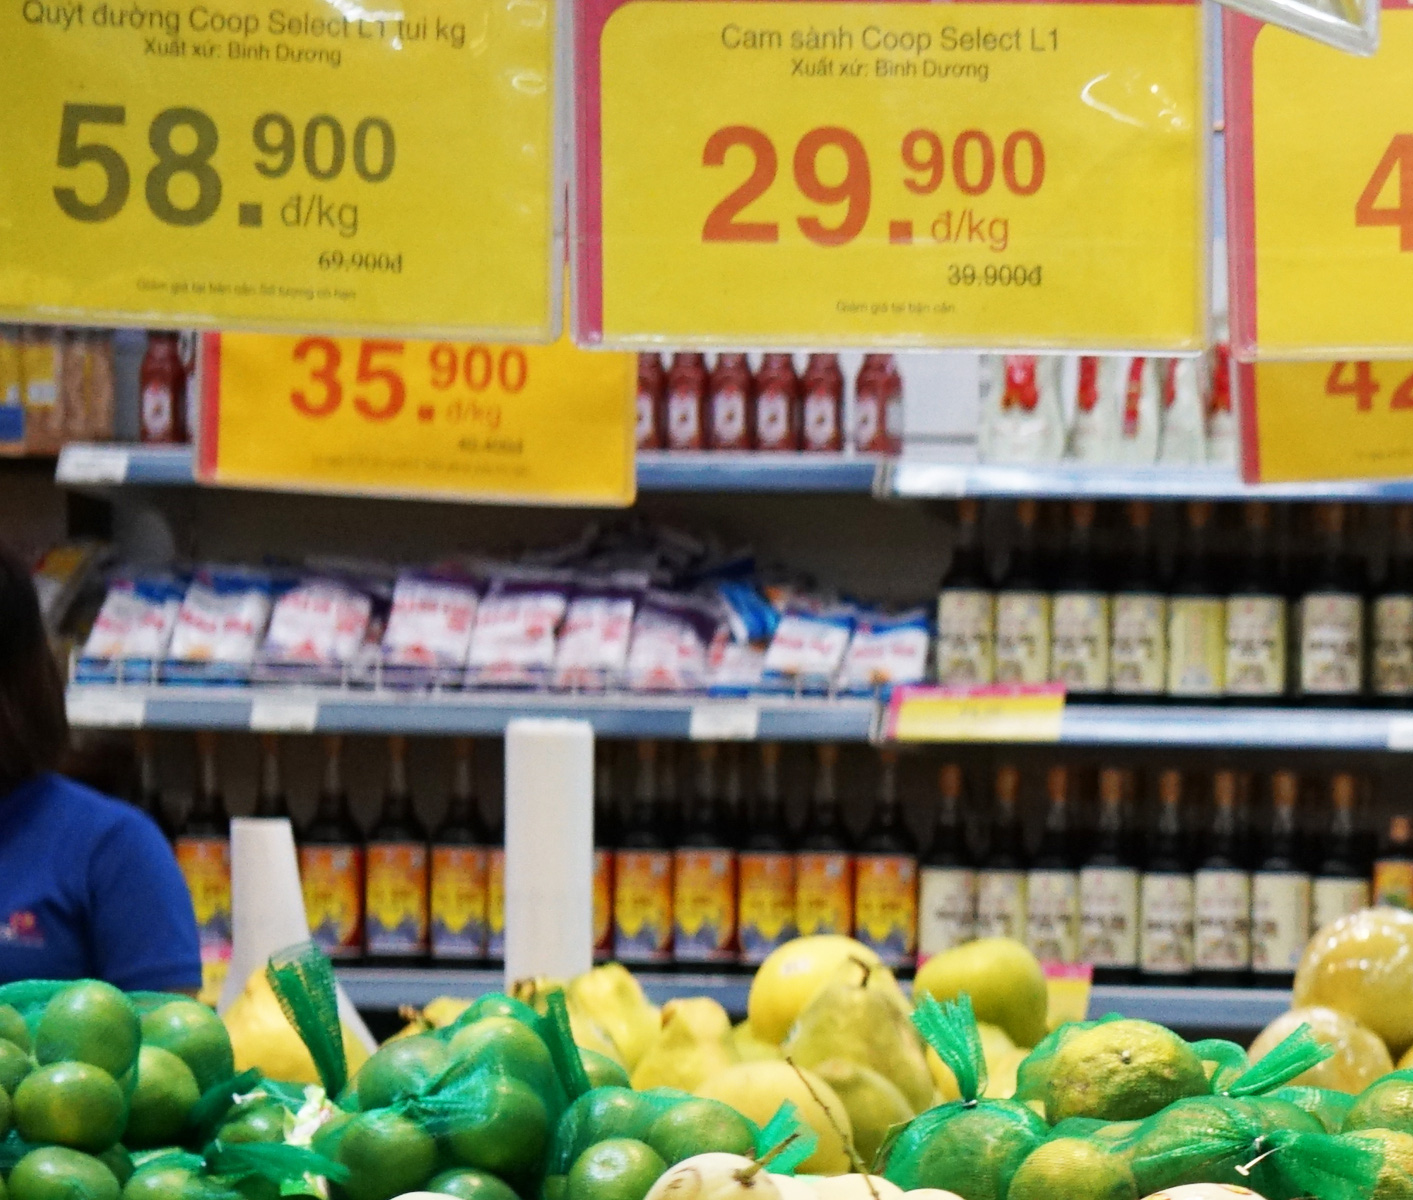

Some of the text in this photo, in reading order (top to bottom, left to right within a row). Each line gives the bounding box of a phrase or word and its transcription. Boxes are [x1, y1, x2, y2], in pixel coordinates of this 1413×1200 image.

[189, 9, 259, 37] Coop
[268, 9, 350, 39] Select
[436, 17, 466, 48] kg
[721, 23, 782, 50] Cam
[862, 26, 932, 55] Coop
[940, 26, 1022, 52] Select
[1031, 28, 1060, 52] L1
[875, 58, 917, 79] Bình
[923, 61, 989, 82] Dương
[929, 209, 1010, 252] đ/kg
